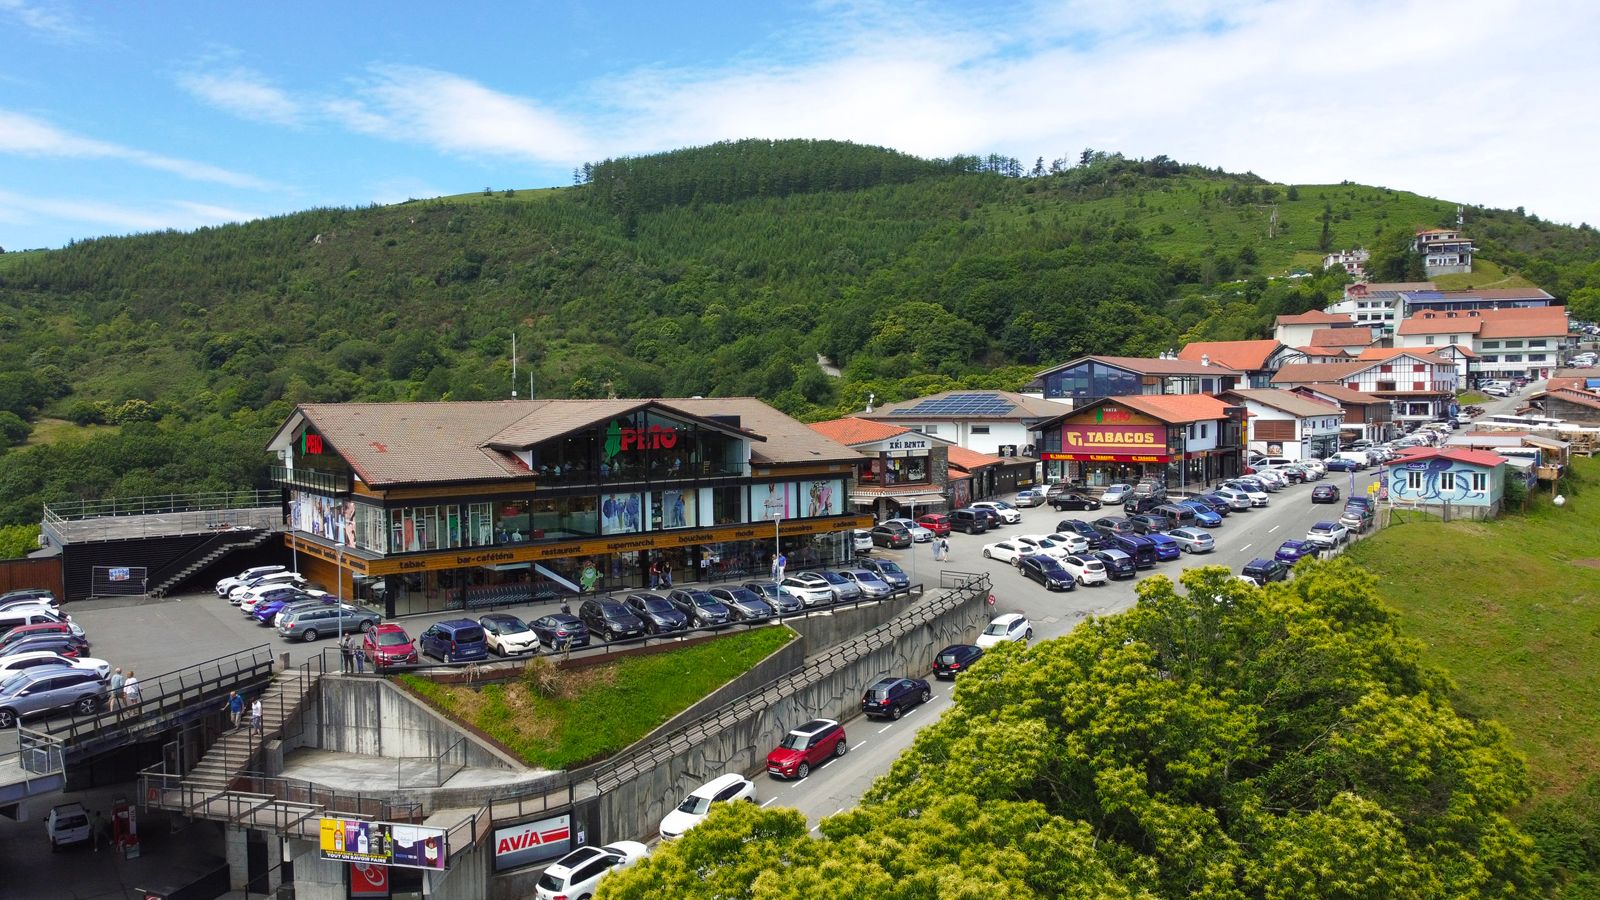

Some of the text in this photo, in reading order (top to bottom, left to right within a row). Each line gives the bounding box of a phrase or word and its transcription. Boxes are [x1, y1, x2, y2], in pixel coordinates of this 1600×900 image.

[904, 441, 925, 449] BENTA
[1087, 432, 1154, 443] TABACOS
[400, 560, 426, 569] tabac
[541, 545, 582, 556] restaurant
[607, 538, 655, 550] supermarché
[678, 533, 713, 543] boucherie
[497, 829, 542, 854] AVIA
